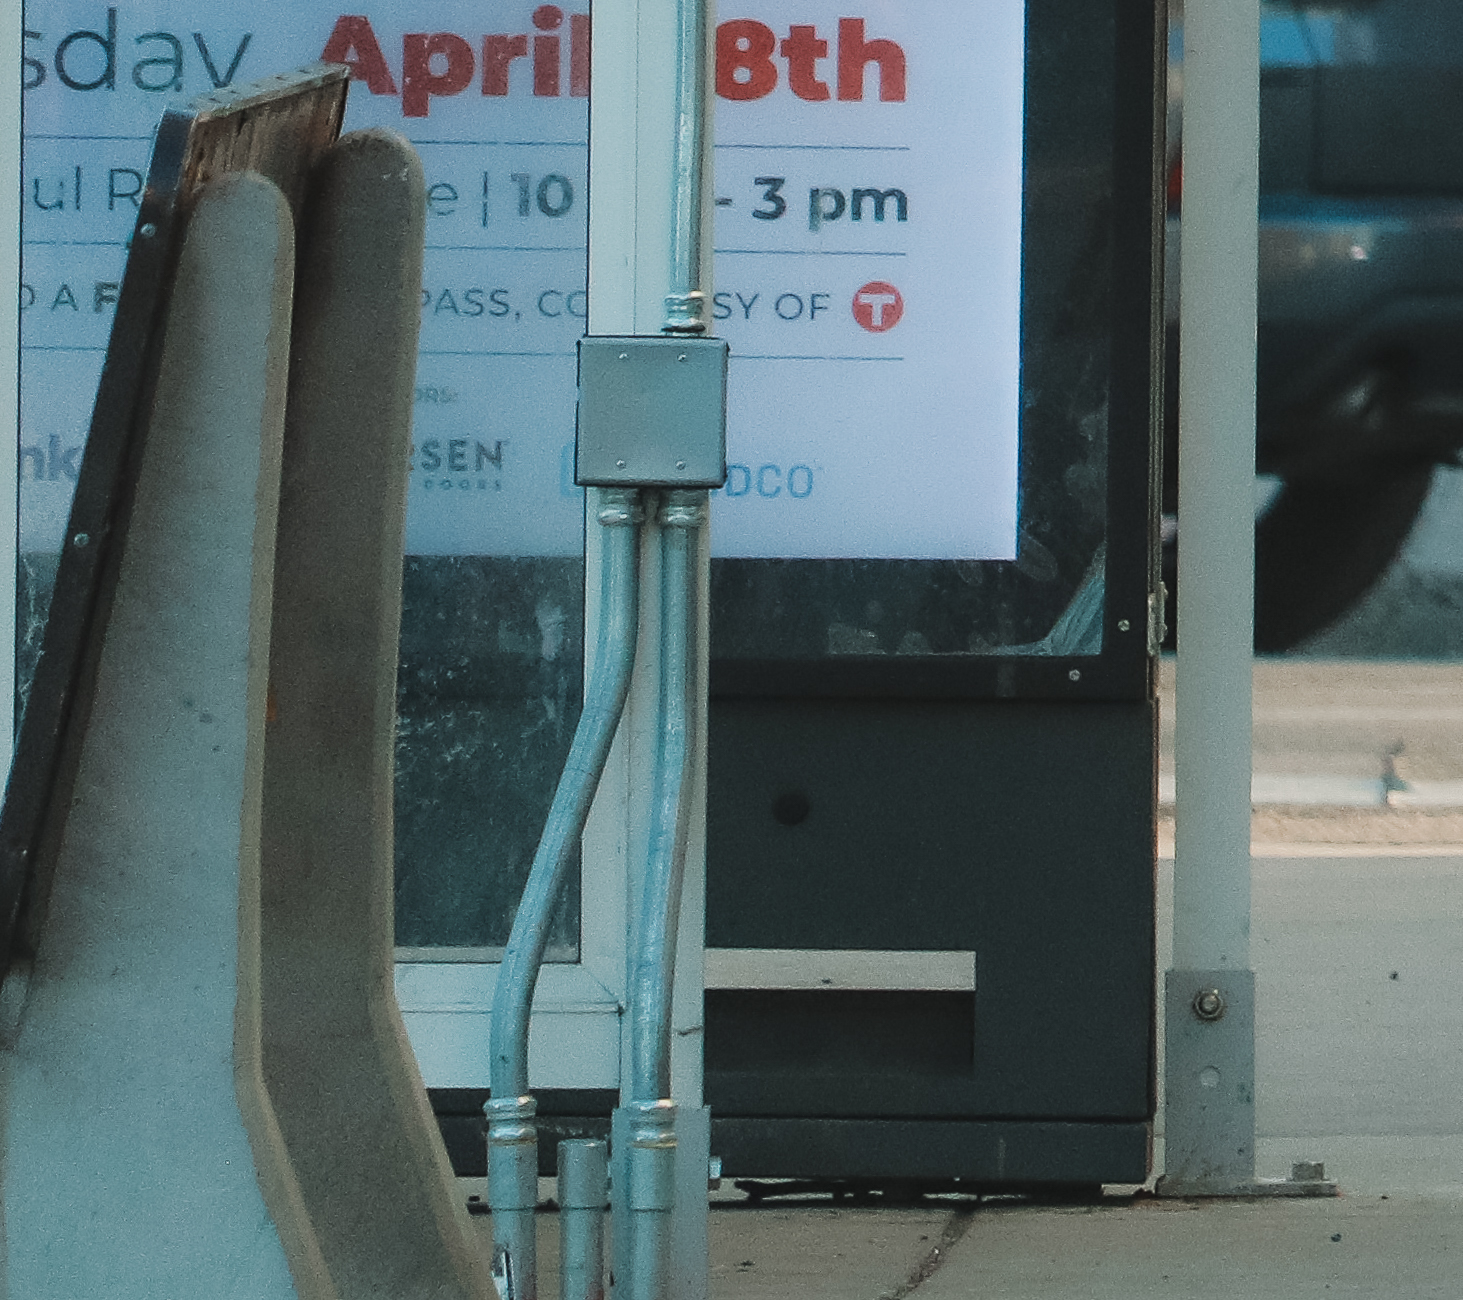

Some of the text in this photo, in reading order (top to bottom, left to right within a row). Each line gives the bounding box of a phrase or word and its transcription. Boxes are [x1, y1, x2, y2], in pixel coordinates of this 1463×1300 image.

[320, 4, 590, 117] April
[510, 173, 574, 218] 10
[751, 176, 787, 221] 3
[808, 185, 909, 233] pm
[775, 293, 830, 320] OF
